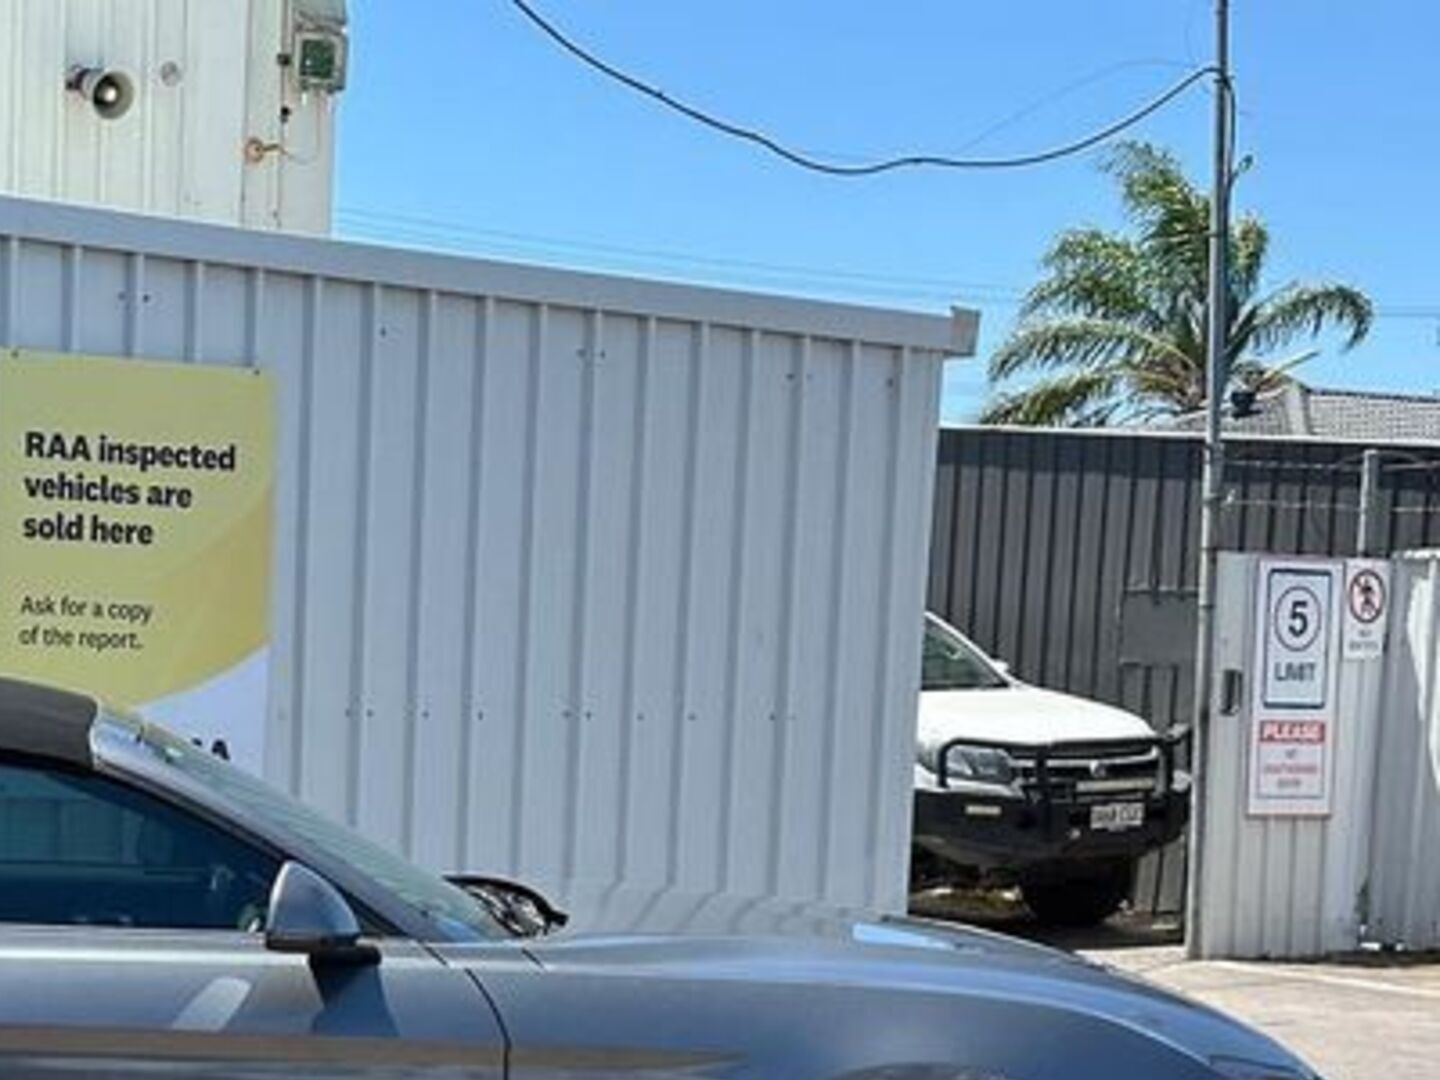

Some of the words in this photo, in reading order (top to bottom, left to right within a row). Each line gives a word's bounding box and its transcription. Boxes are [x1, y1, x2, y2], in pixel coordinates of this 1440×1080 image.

[25, 431, 91, 461] RAA
[98, 435, 236, 472] inspected
[24, 474, 140, 505] vehicles
[146, 488, 193, 508] are
[23, 513, 84, 542] sold
[90, 517, 155, 545] here
[20, 596, 56, 616] Ask
[60, 596, 87, 617] for
[92, 603, 104, 619] a
[107, 603, 153, 625] copy
[1288, 601, 1309, 637] 5
[18, 626, 39, 645] of
[42, 627, 74, 648] the
[78, 630, 144, 653] report.
